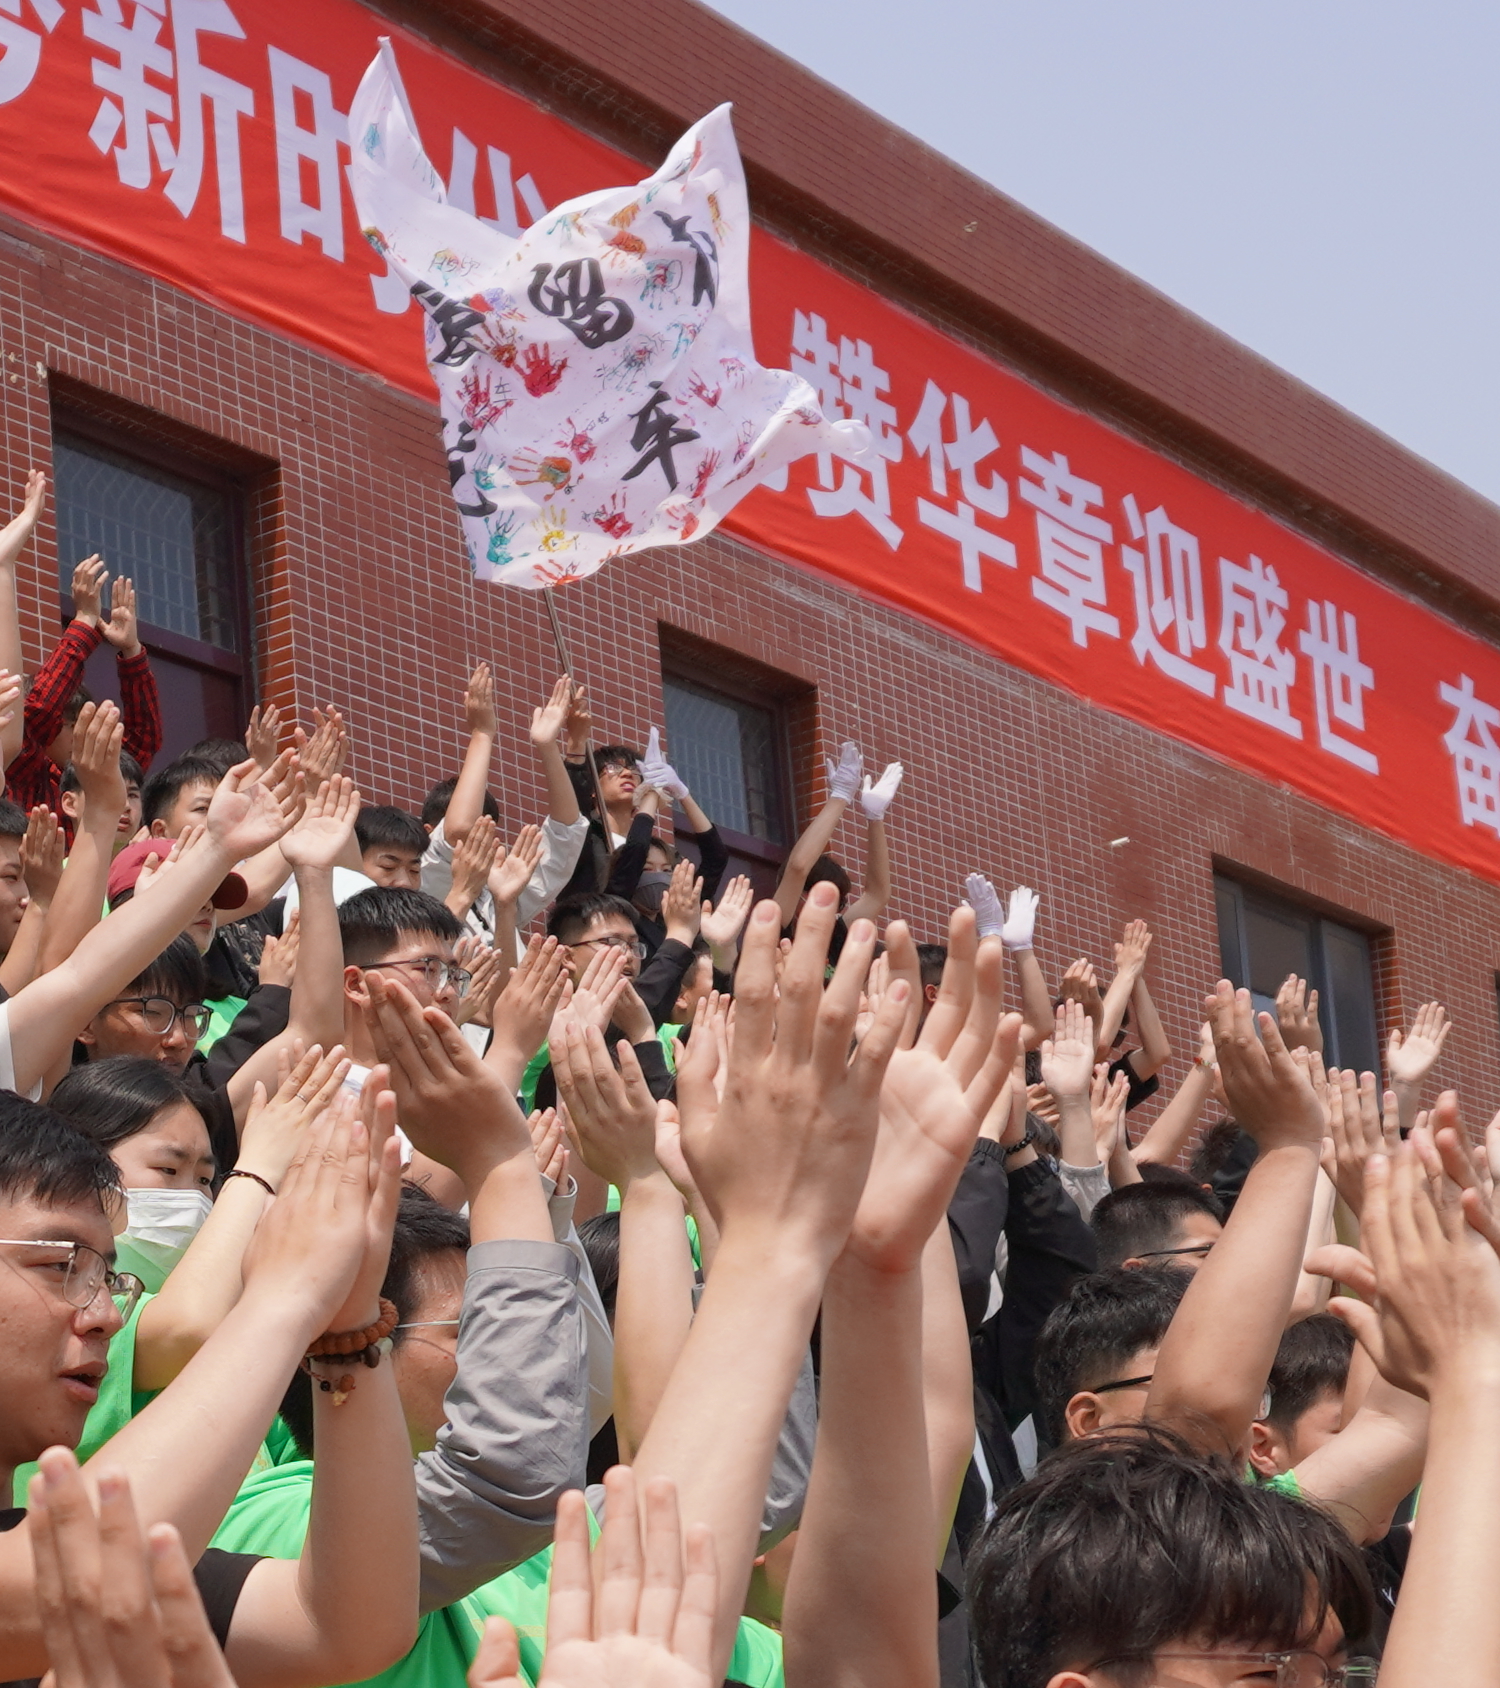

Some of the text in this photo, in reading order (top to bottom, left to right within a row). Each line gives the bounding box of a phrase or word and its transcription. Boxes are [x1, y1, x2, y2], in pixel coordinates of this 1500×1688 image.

[755, 308, 1380, 775] 赞华章迎盛世
